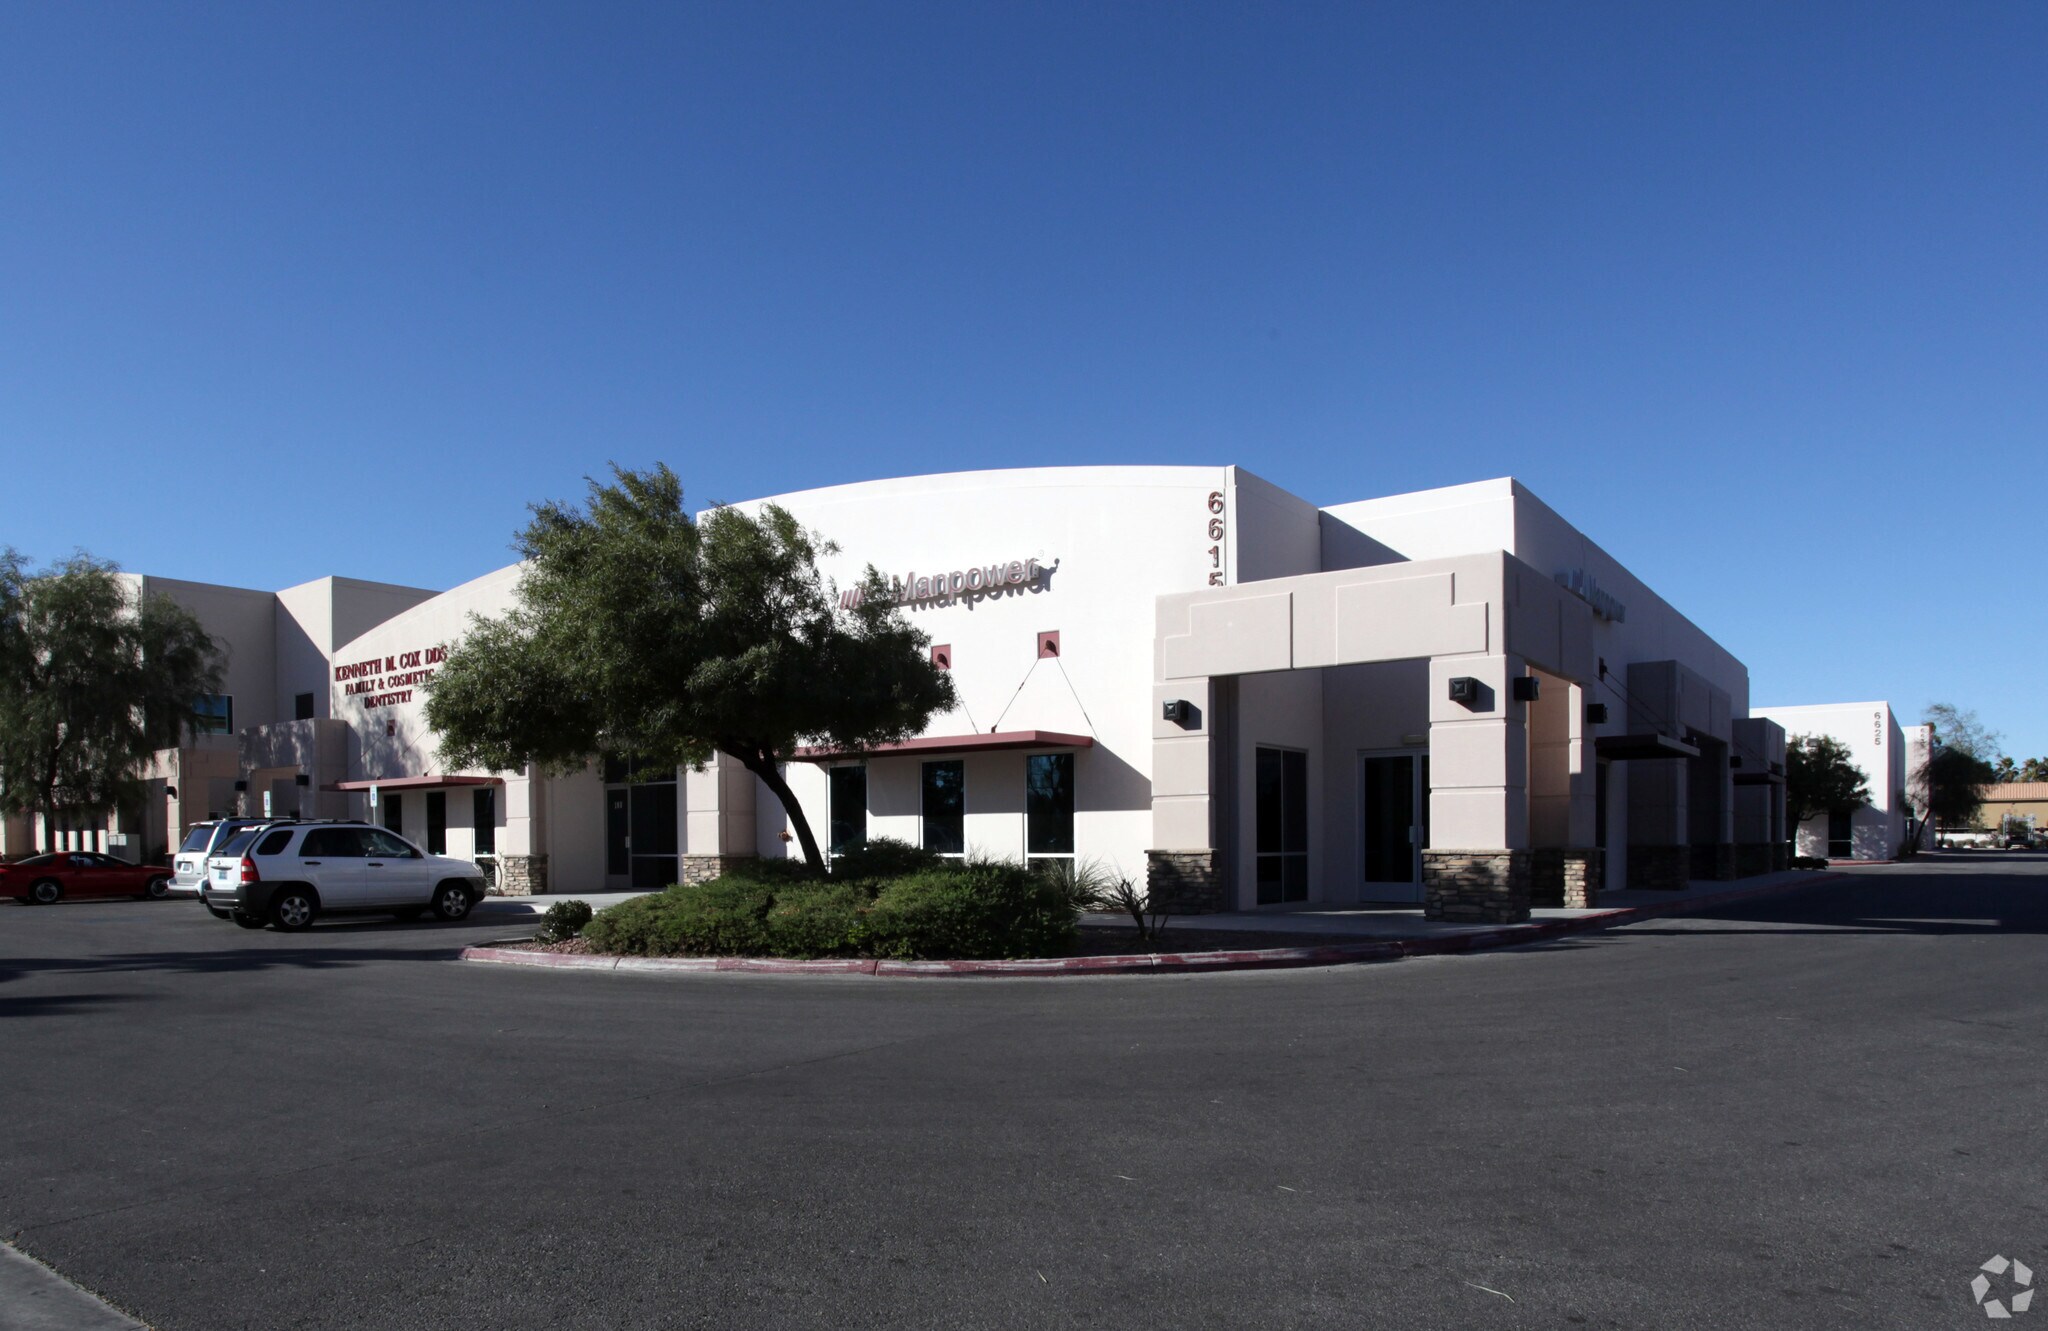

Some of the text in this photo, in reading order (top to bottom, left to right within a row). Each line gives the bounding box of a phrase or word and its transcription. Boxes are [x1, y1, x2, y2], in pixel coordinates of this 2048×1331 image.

[892, 557, 1039, 602] Manpower
[335, 645, 448, 682] KENNETH M. COX DDS
[345, 679, 376, 696] FAMILY
[378, 678, 385, 690] &
[364, 689, 413, 709] DENTISTRY
